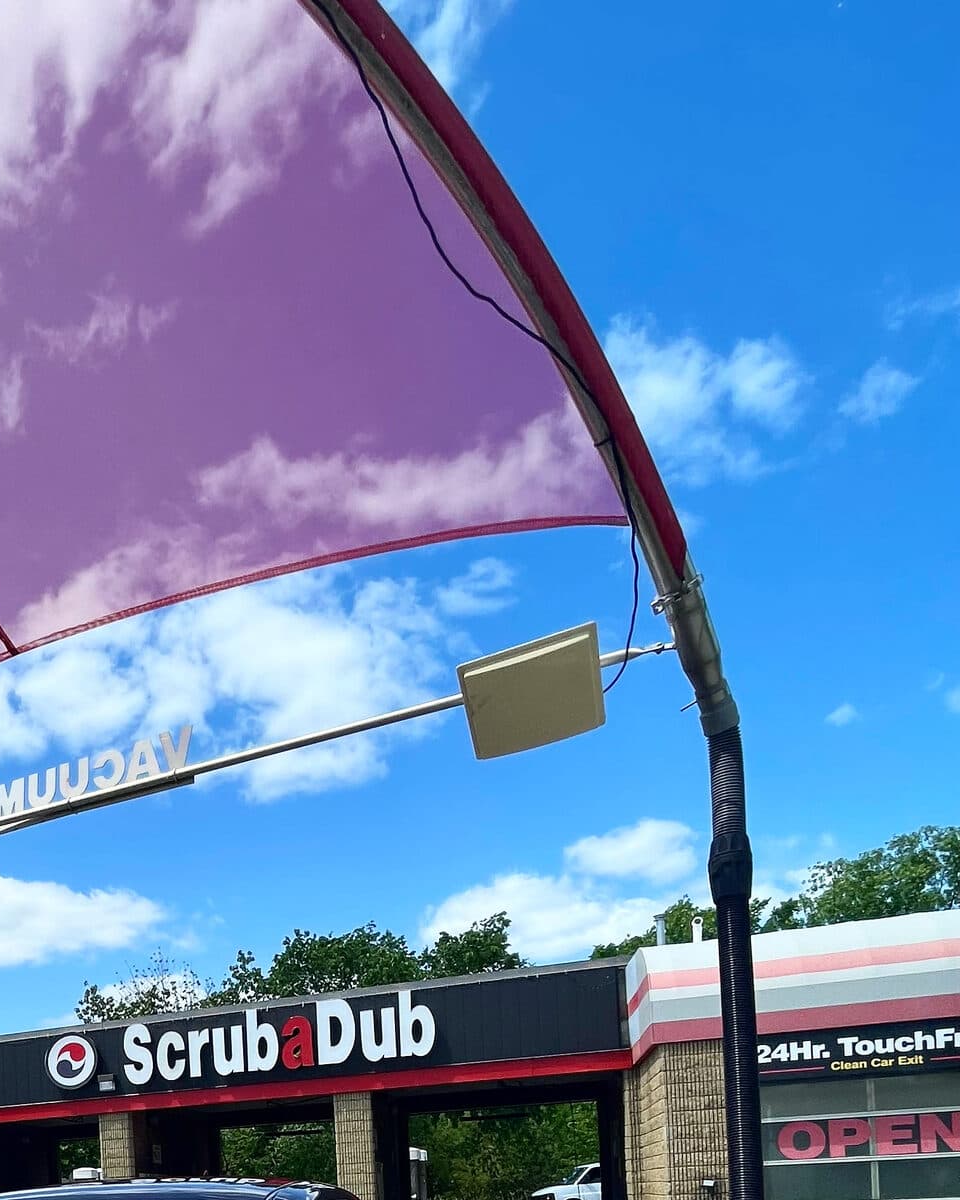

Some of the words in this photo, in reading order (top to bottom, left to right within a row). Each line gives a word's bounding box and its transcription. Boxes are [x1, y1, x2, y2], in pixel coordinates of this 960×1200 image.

[757, 1040, 830, 1064] 24Hr.
[830, 1060, 868, 1071] Clean
[870, 1058, 895, 1068] Car
[897, 1054, 924, 1066] Exit
[777, 1111, 960, 1161] OPEN
